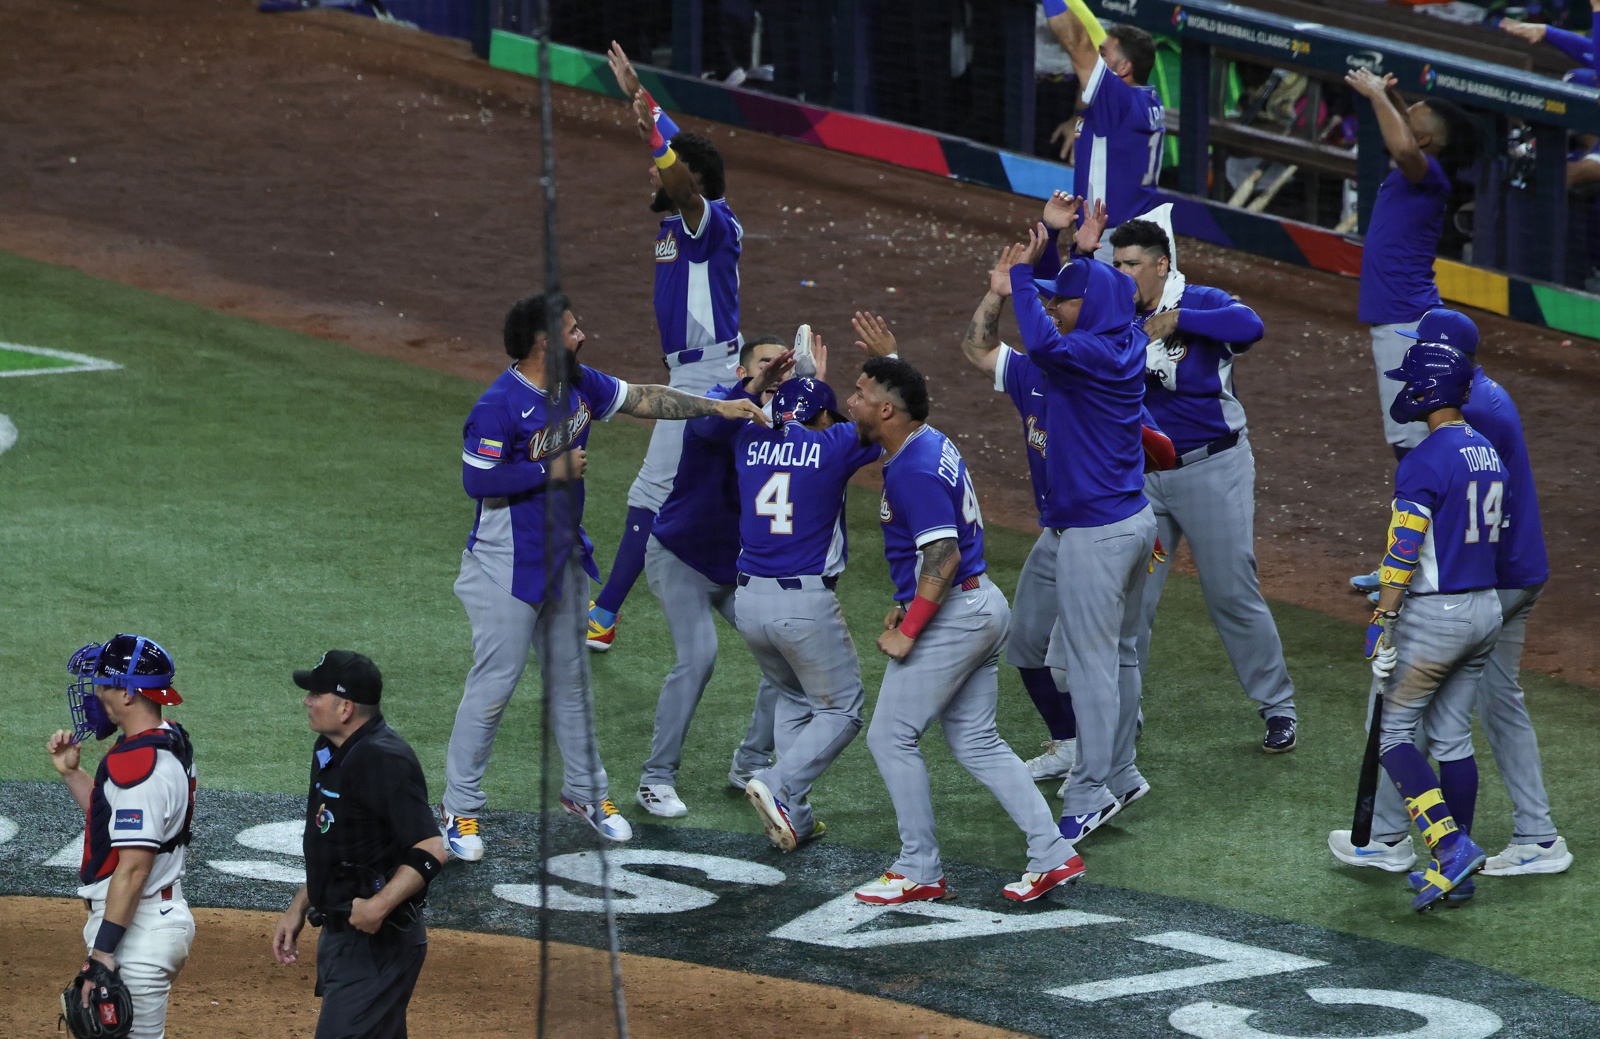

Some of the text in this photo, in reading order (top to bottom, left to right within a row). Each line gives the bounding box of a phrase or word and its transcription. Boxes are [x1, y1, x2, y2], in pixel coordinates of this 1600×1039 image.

[746, 441, 821, 469] SANOJA
[1459, 446, 1501, 472] TOVAR
[755, 472, 793, 534] 4
[1465, 481, 1504, 544] 14
